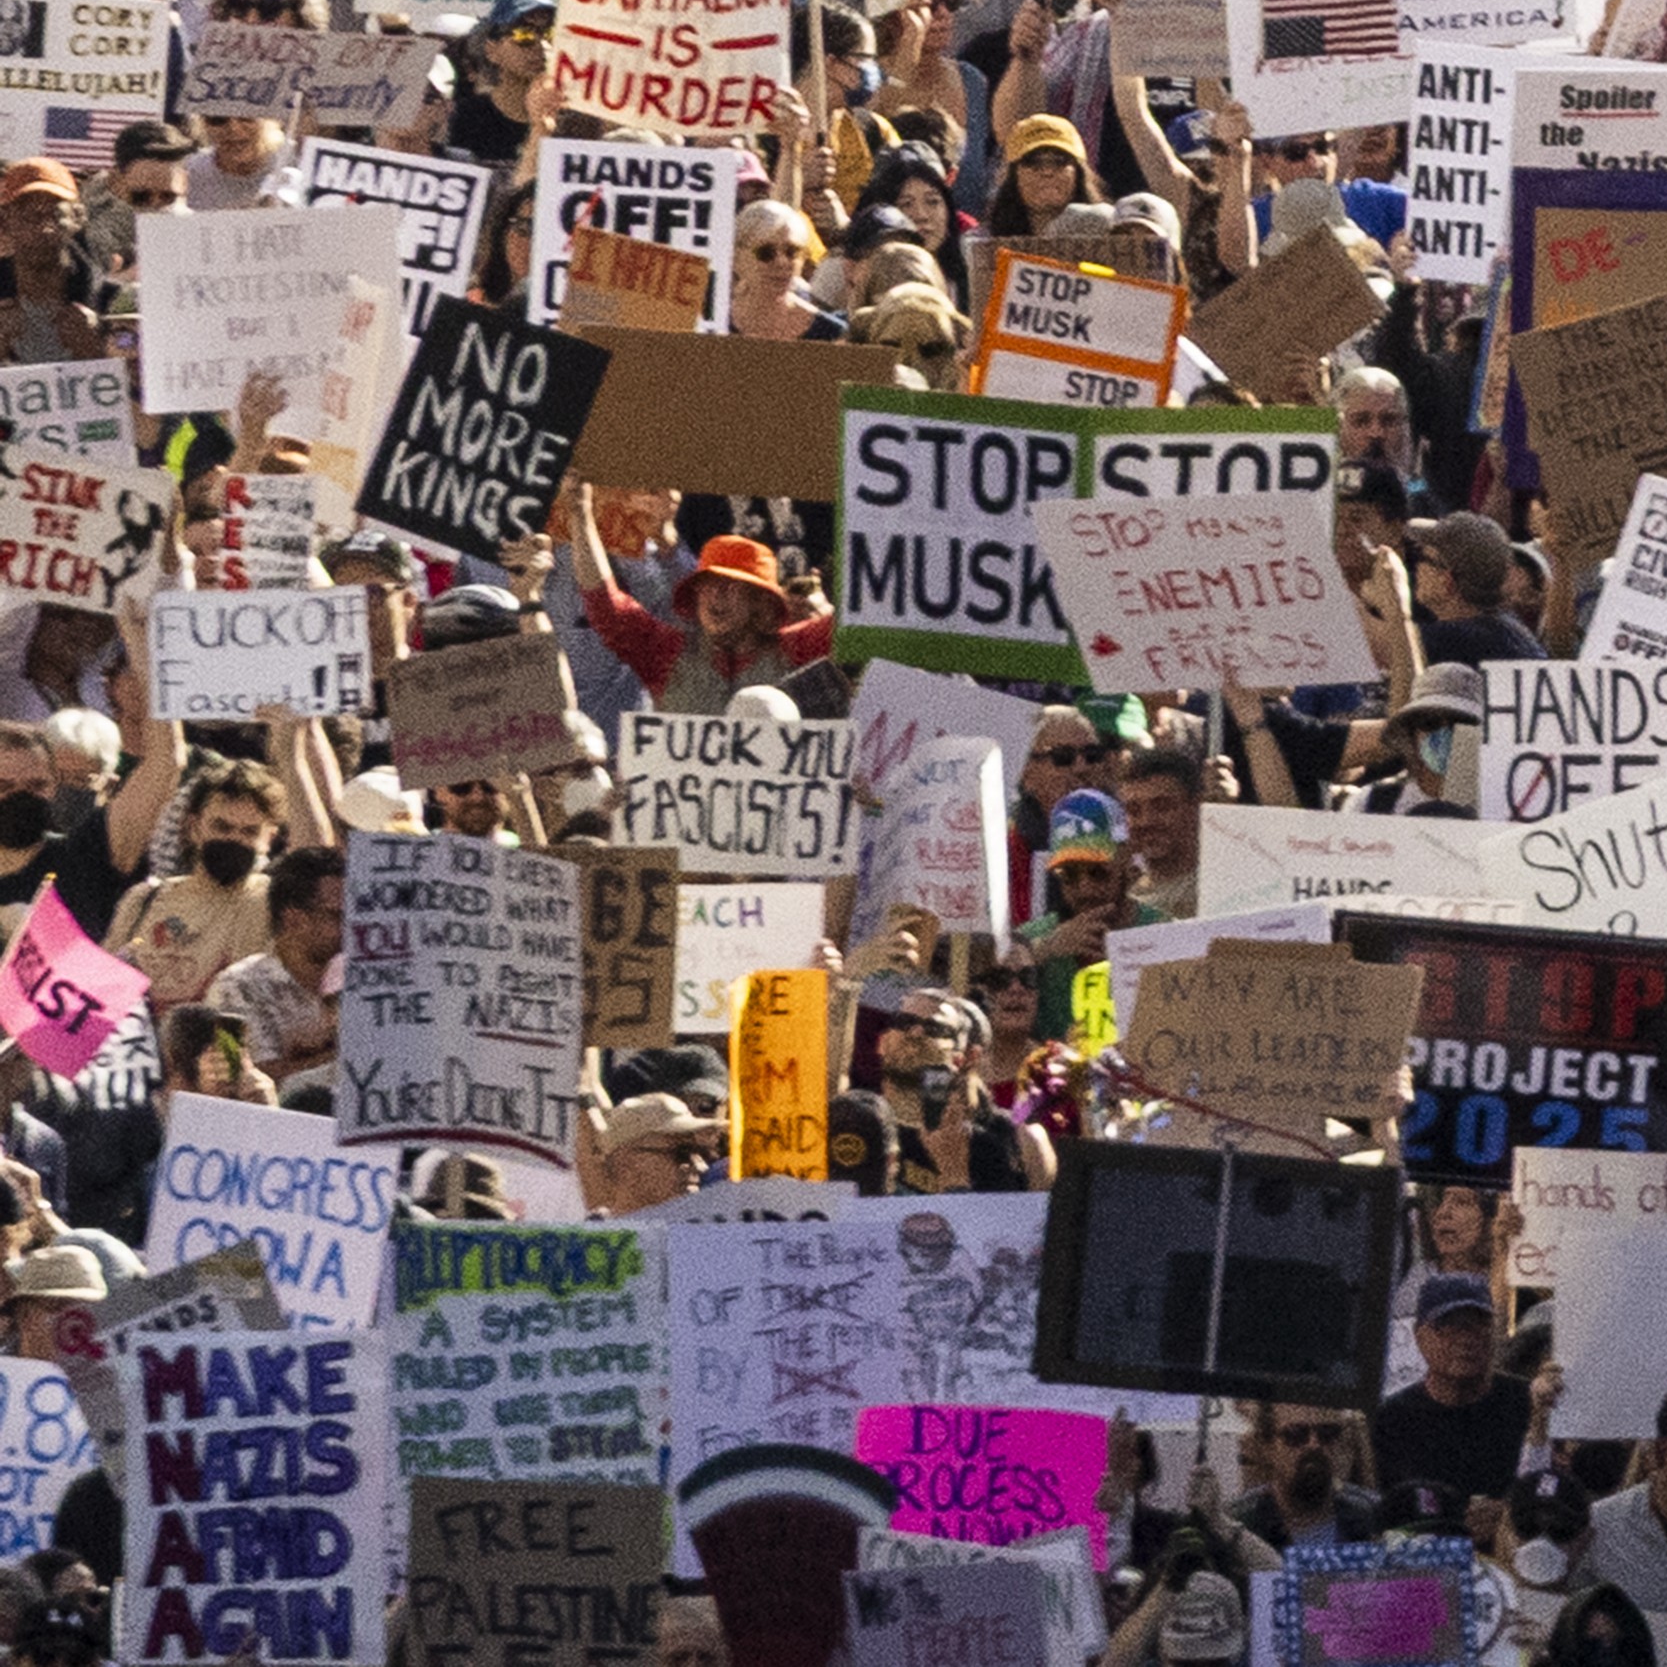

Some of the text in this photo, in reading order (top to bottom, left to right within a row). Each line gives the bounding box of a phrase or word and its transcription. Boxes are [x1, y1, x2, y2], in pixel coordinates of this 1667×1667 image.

[651, 26, 701, 64] IS
[556, 56, 780, 125] MURDER
[1418, 64, 1504, 103] ANTI-
[1561, 85, 1656, 114] Spoiler
[1016, 269, 1092, 303] STOP
[1006, 304, 1092, 342] MUSK
[457, 322, 548, 405] NO
[407, 379, 574, 485] MORE
[382, 448, 544, 535] KINGS
[858, 425, 1072, 512] STOP
[849, 541, 1068, 627] MUSK
[158, 606, 289, 648] FUCK
[634, 716, 851, 780] FUCK YOU
[166, 1148, 388, 1229] CONGRESS
[139, 1344, 356, 1422] MAKE
[146, 1423, 359, 1505] NAZIS
[146, 1587, 356, 1658] AGAIN
